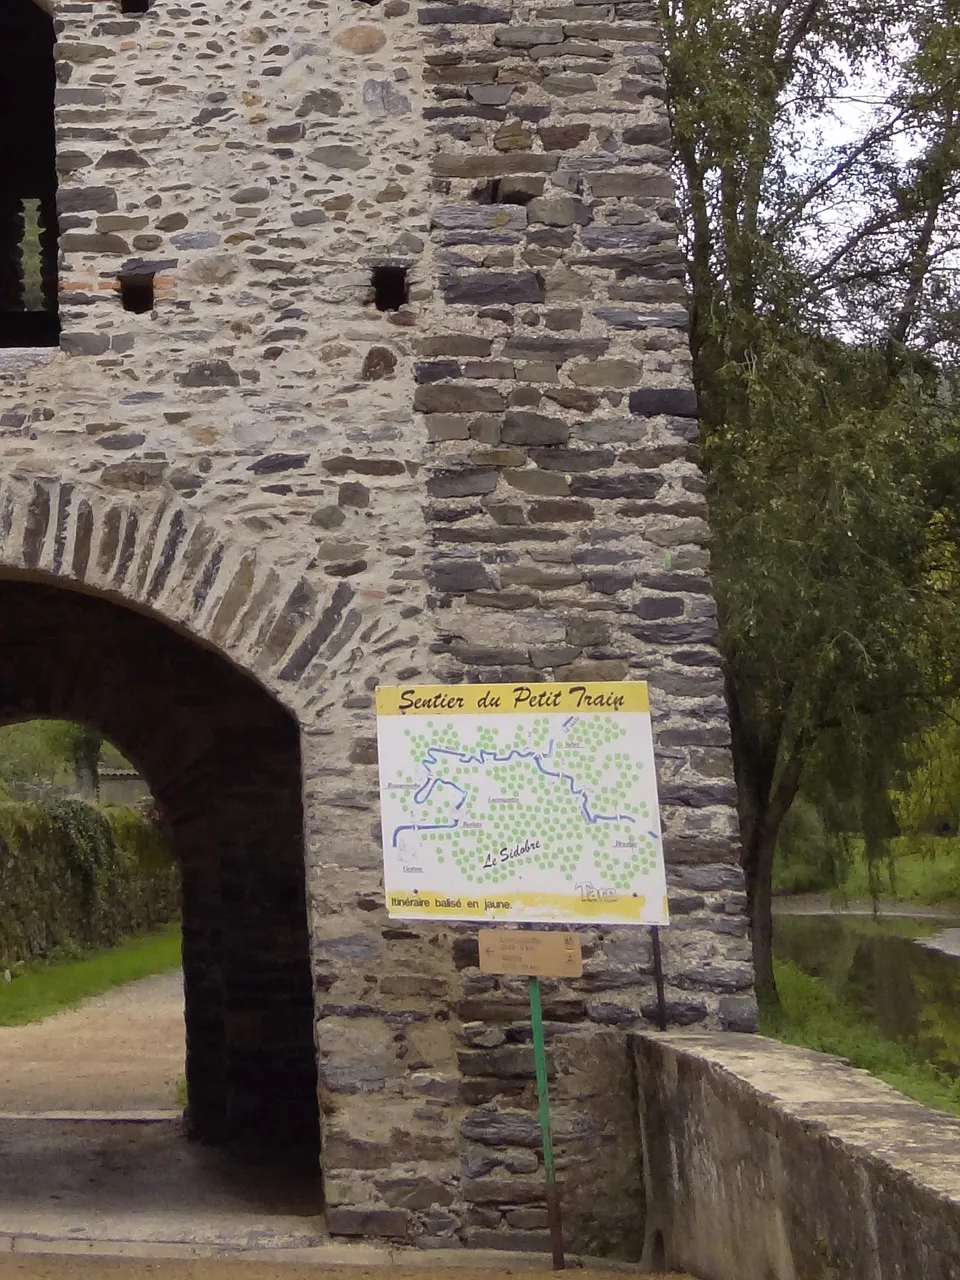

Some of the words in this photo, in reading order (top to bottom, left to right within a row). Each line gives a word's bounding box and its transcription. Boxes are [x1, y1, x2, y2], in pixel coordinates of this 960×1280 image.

[398, 689, 465, 710] Sentier
[477, 690, 502, 708] du
[512, 686, 562, 709] Petit
[568, 686, 625, 708] Train
[483, 853, 497, 869] Le
[500, 839, 541, 862] Sidobre
[391, 896, 430, 908] Itinéraire
[434, 897, 462, 909] balisé
[466, 901, 480, 909] en
[484, 898, 513, 911] jaune.
